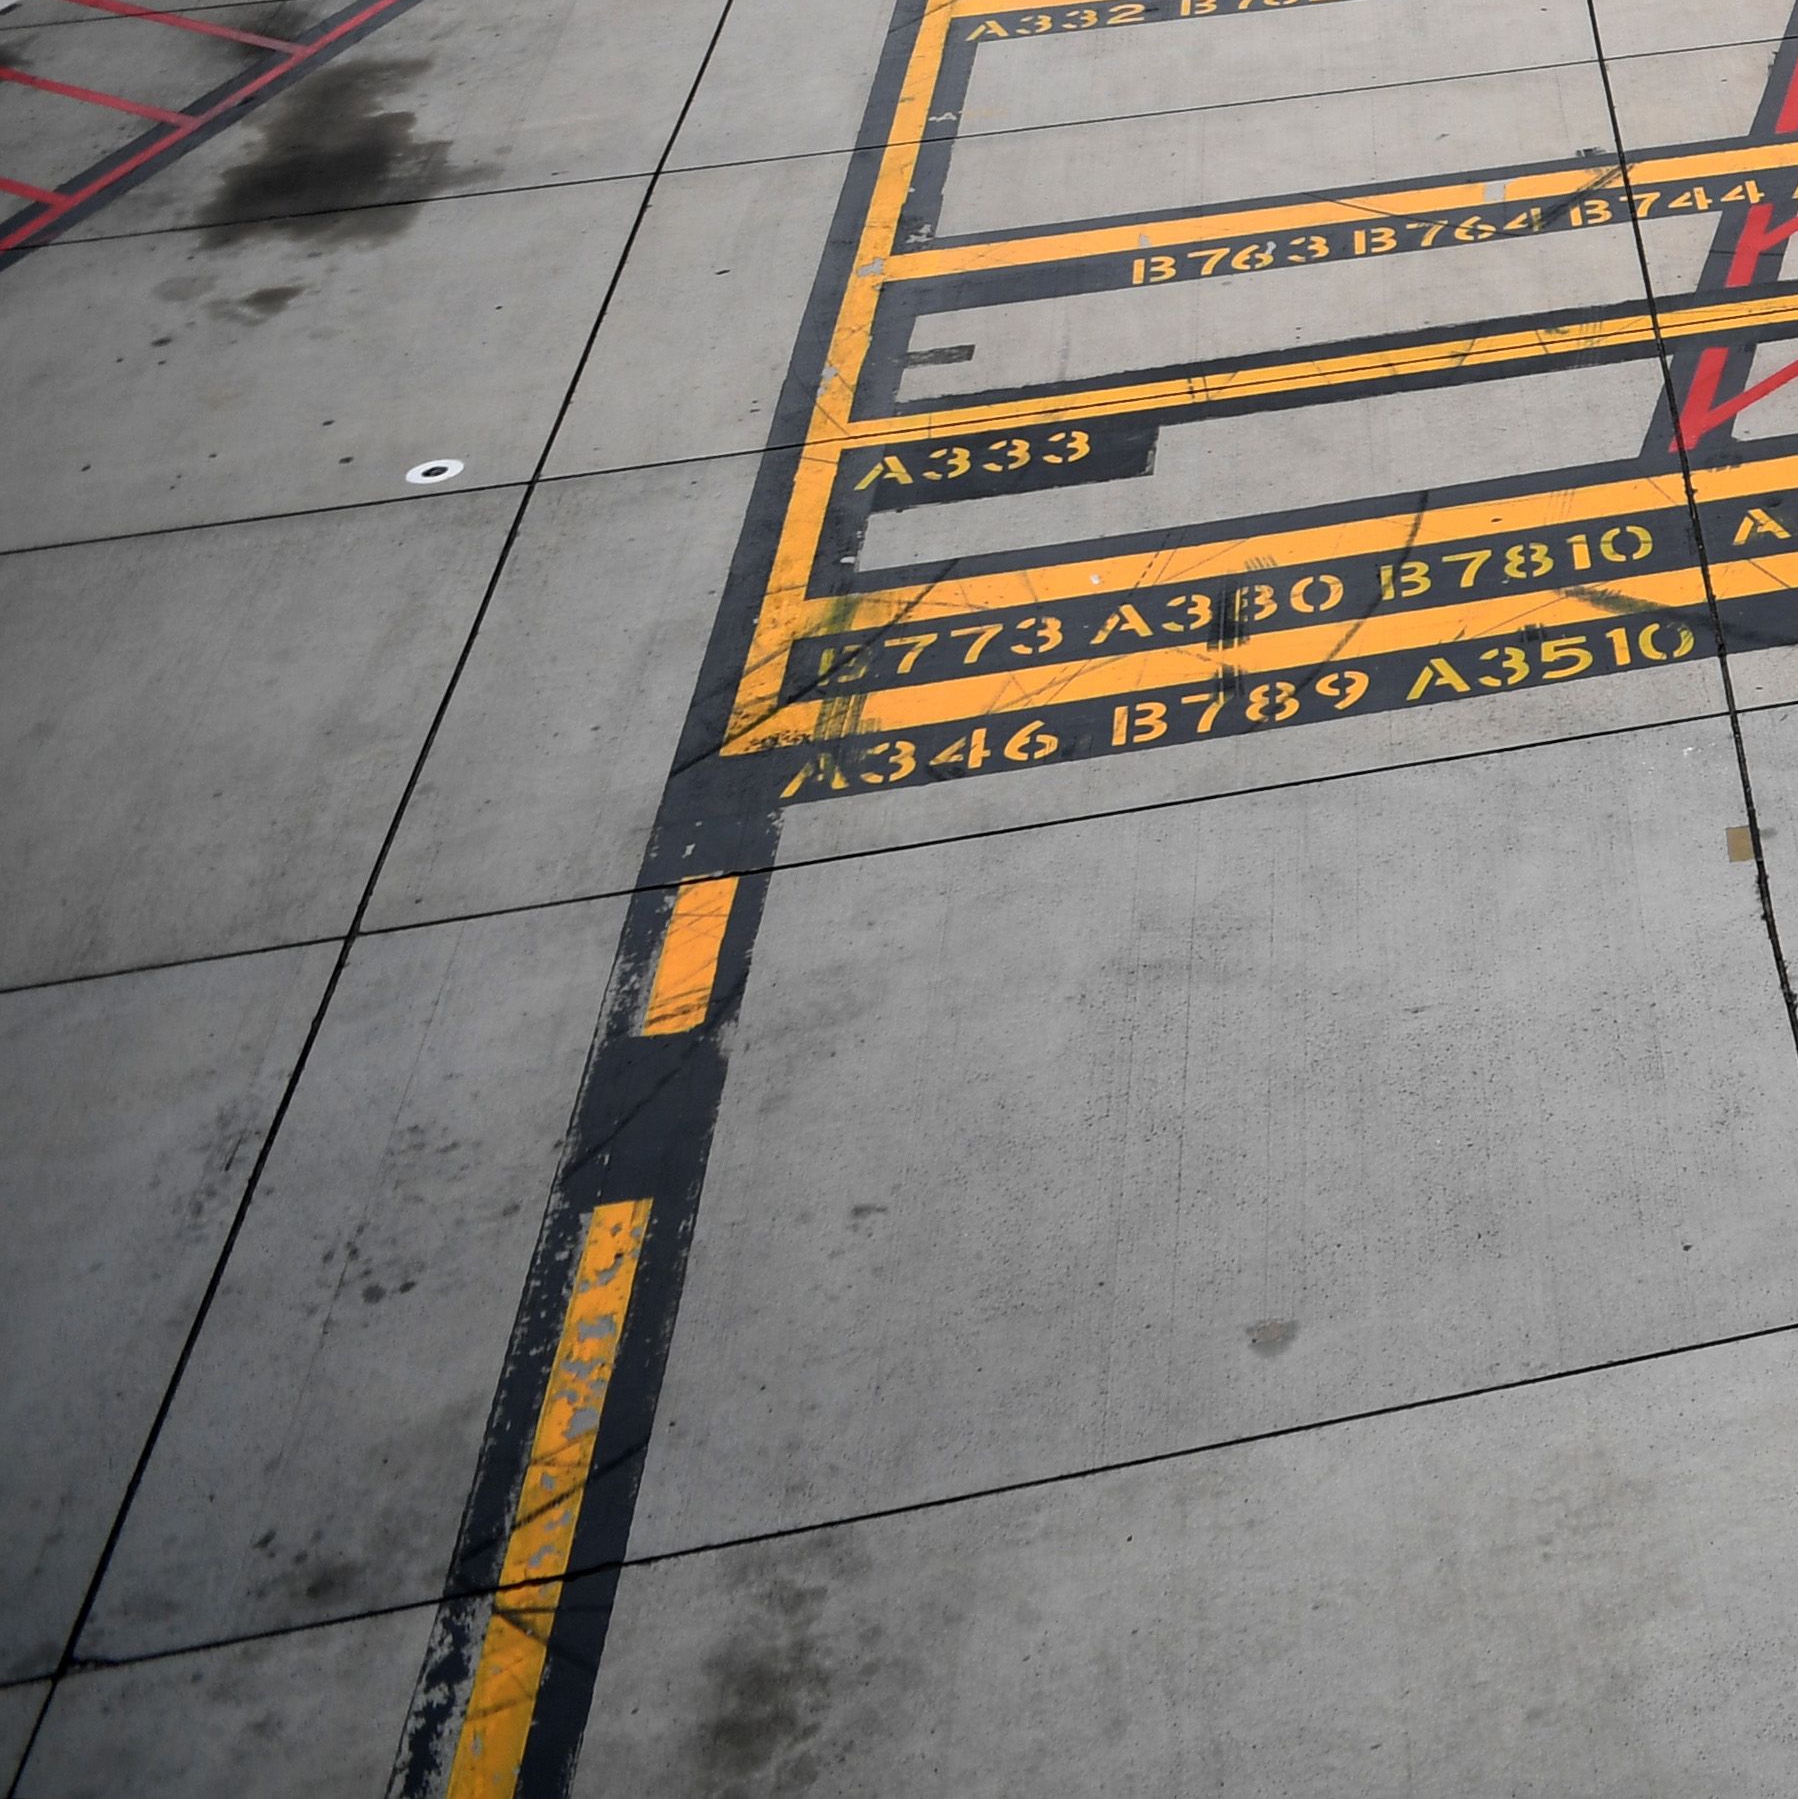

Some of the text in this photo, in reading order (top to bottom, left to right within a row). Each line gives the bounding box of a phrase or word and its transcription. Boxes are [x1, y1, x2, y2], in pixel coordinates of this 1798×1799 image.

[966, 4, 1146, 42] A332
[1132, 235, 1330, 286] B763
[1354, 208, 1545, 257] B764
[1569, 180, 1764, 229] B744
[855, 429, 1091, 490] A333
[819, 616, 1064, 687] B773
[1379, 525, 1653, 601] B7810
[780, 622, 1695, 799] A346 B789 A3510
